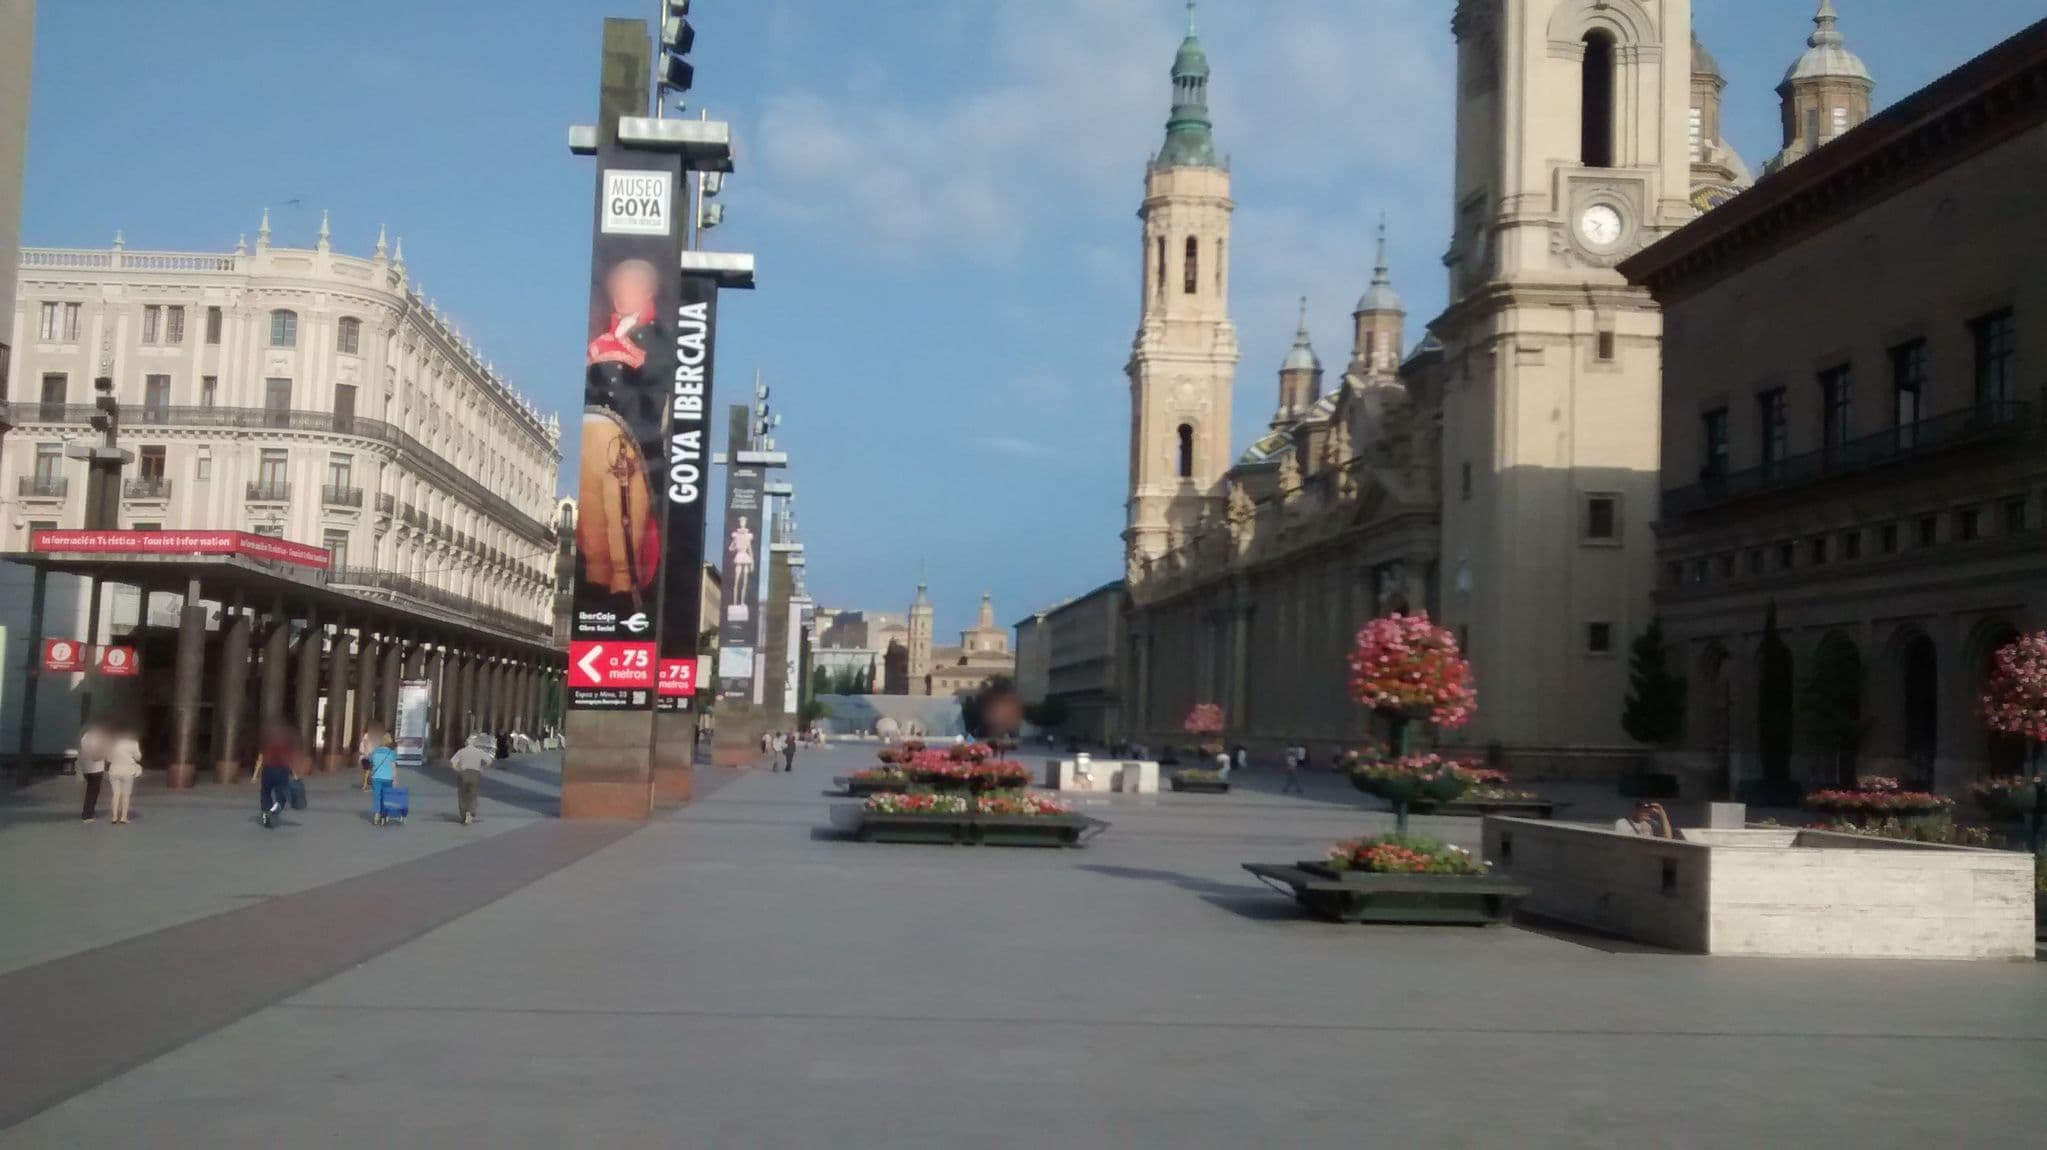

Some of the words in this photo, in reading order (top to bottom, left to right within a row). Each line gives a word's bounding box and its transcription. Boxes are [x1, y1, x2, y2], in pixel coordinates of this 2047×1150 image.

[611, 177, 663, 197] MUSEO
[611, 197, 662, 218] GOYA
[673, 301, 707, 421] IBERCAJA
[668, 430, 702, 504] GOYA
[41, 535, 96, 546] Información
[143, 535, 175, 546] Tourist
[175, 536, 230, 547] Information
[578, 611, 617, 623] IberCaja
[609, 657, 619, 666] a
[622, 649, 649, 667] 75
[609, 668, 648, 680] metros
[669, 665, 690, 679] 75
[658, 679, 690, 689] metros
